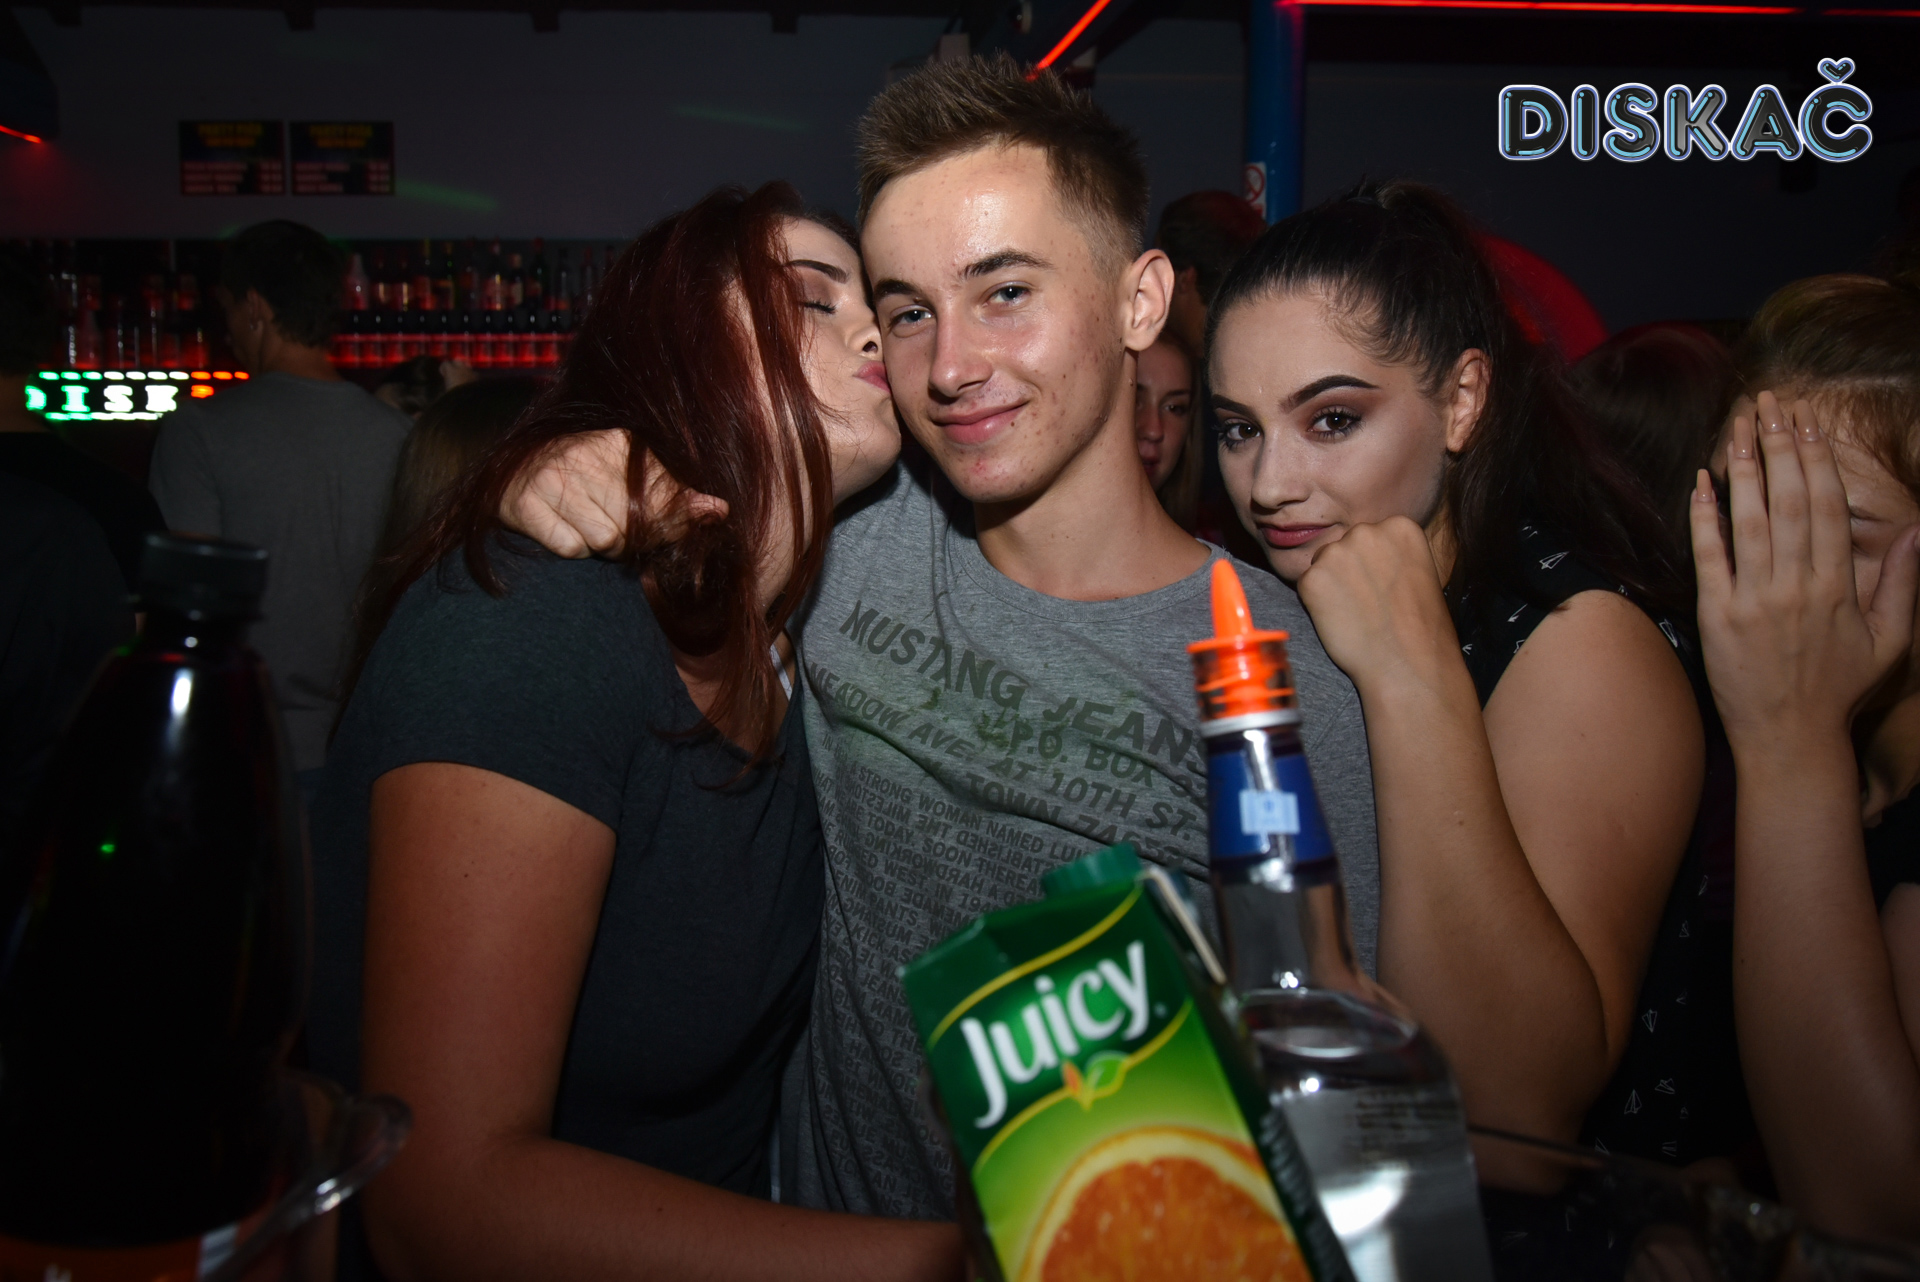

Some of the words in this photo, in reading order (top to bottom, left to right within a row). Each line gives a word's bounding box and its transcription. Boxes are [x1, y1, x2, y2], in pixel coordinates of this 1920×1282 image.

[25, 384, 214, 413] DISK
[839, 599, 1029, 711] MUSTANG
[1042, 697, 1208, 777] JEAN
[966, 772, 1062, 825] TOWN
[986, 757, 1037, 781] AT
[1045, 772, 1137, 819] 10TH
[1145, 802, 1197, 841] ST.
[1085, 742, 1153, 788] BOX
[858, 766, 912, 804] STRONG
[918, 794, 982, 831] WOMAN
[986, 820, 1044, 853] NAMED
[868, 811, 915, 846] TODAY.
[922, 837, 972, 868] SOON
[974, 857, 1045, 897] THEREA
[884, 858, 929, 893] WEST.
[935, 882, 953, 903] IN
[868, 891, 922, 929] PANTS.
[960, 940, 1149, 1128] Juicy
